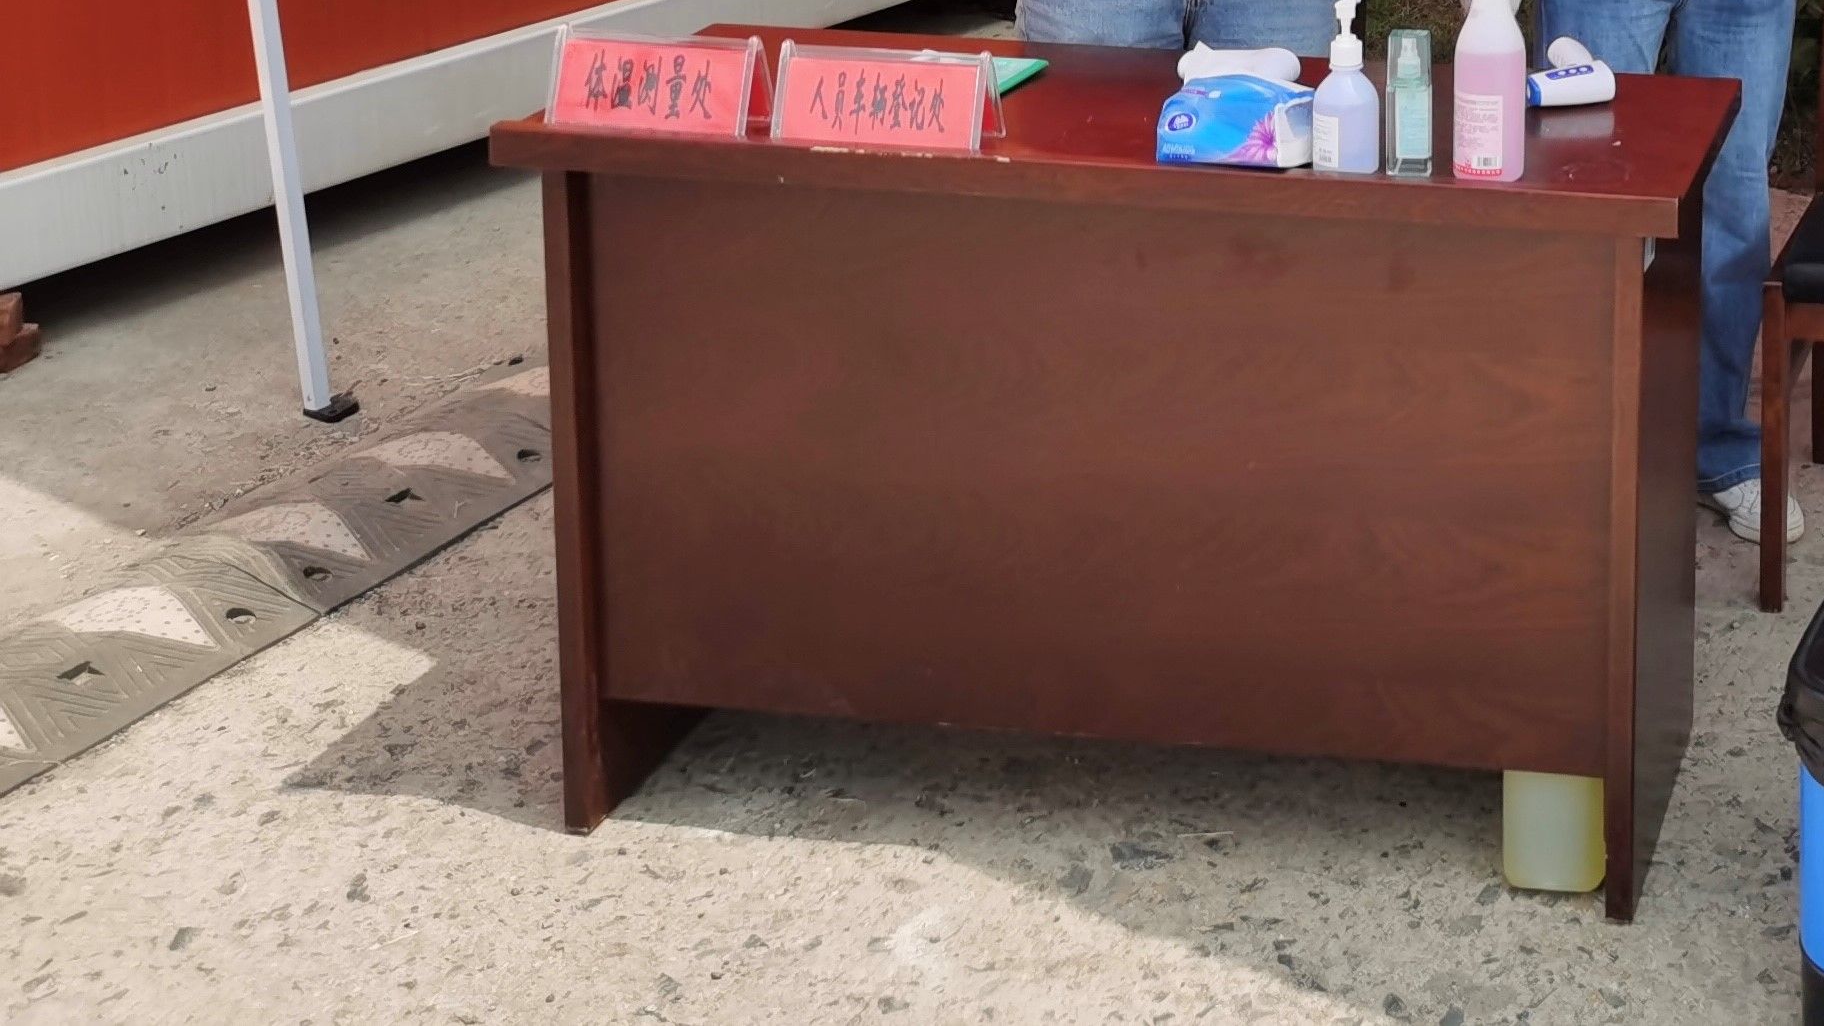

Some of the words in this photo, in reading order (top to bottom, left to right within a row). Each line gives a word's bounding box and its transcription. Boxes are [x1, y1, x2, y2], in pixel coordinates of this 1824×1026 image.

[584, 48, 713, 120] 体温测量处
[809, 68, 945, 135] 人员车辆登记处
